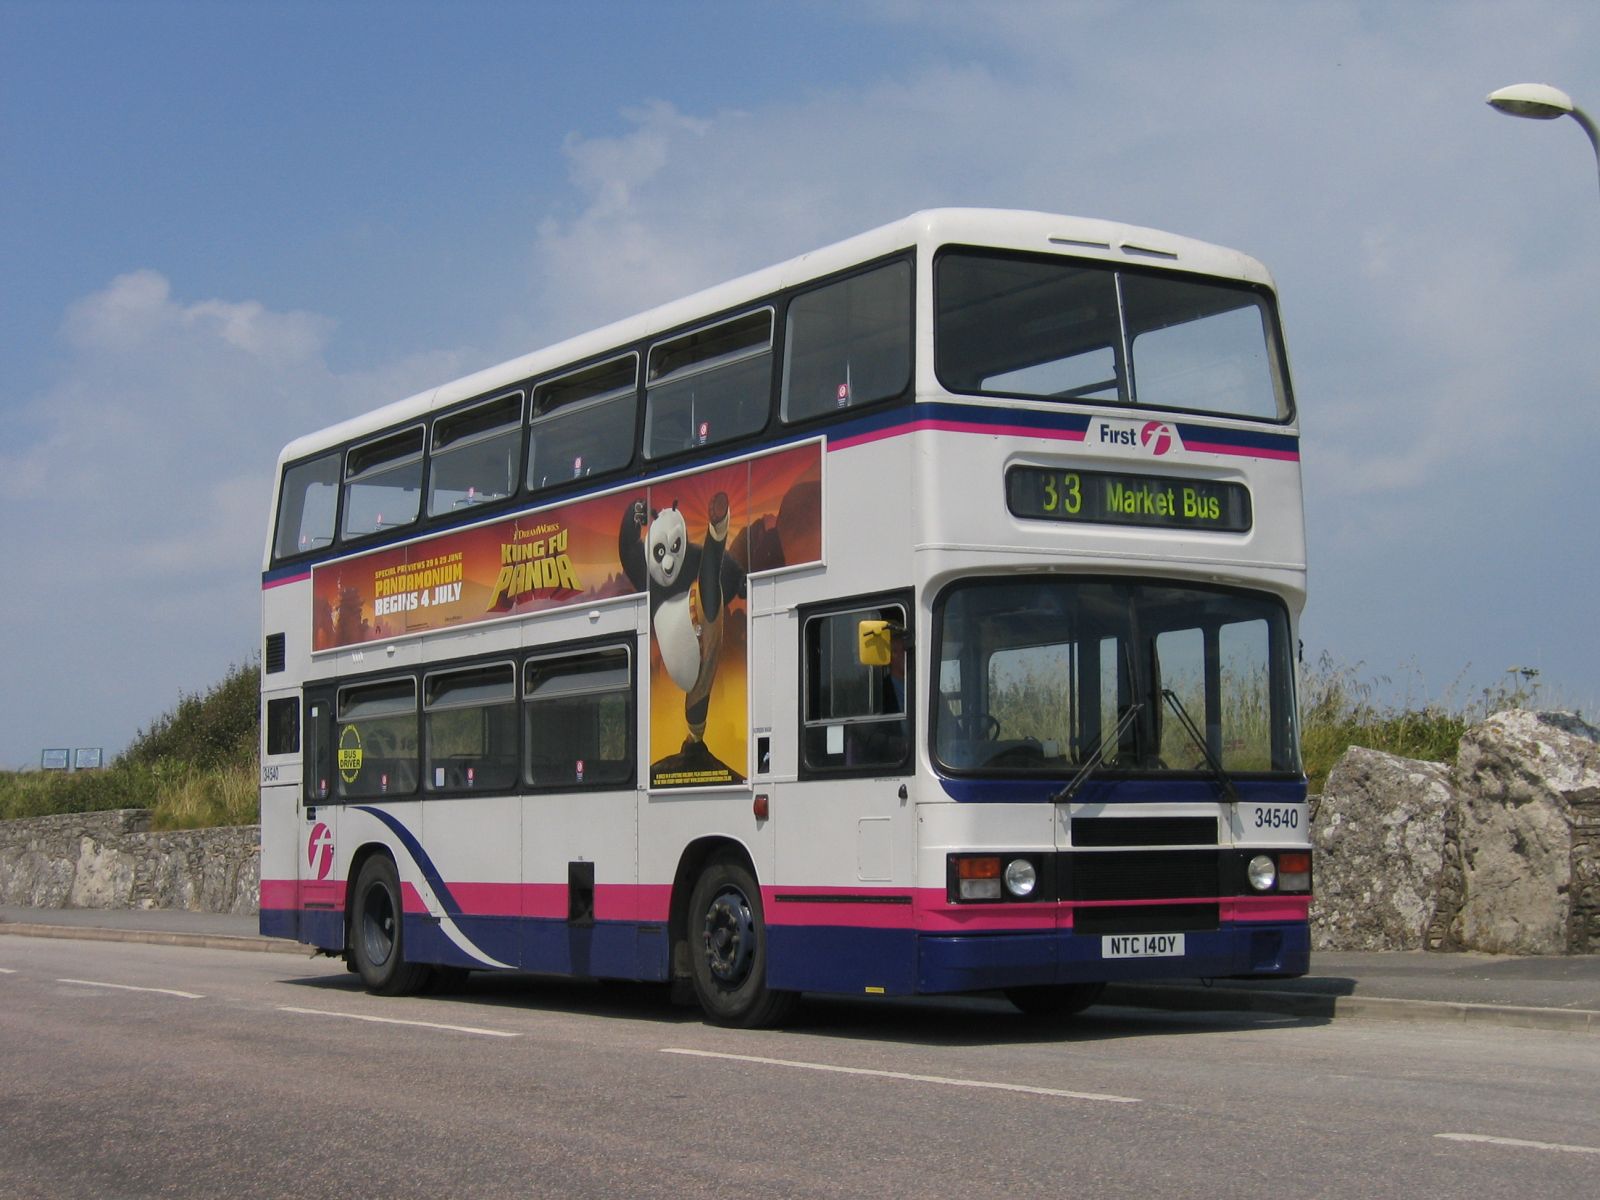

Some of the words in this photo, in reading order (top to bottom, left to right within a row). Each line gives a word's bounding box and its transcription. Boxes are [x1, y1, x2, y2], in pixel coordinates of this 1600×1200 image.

[1100, 424, 1136, 446] First
[1041, 473, 1083, 514] 33
[1106, 481, 1176, 516] Market
[1183, 487, 1220, 520] Bus
[501, 540, 545, 564] KUNG
[548, 528, 568, 555] FU
[447, 552, 462, 563] JUNE
[375, 562, 463, 598] PANDAMONIUM
[486, 553, 584, 611] PANDA
[375, 591, 418, 617] BEGINS
[421, 589, 430, 608] 4
[431, 582, 463, 606] JULY
[340, 759, 361, 768] DRIVER
[343, 750, 357, 759] BUS
[1255, 808, 1298, 829] 34540
[1111, 937, 1139, 955] NTC
[1144, 936, 1176, 954] 140Y
